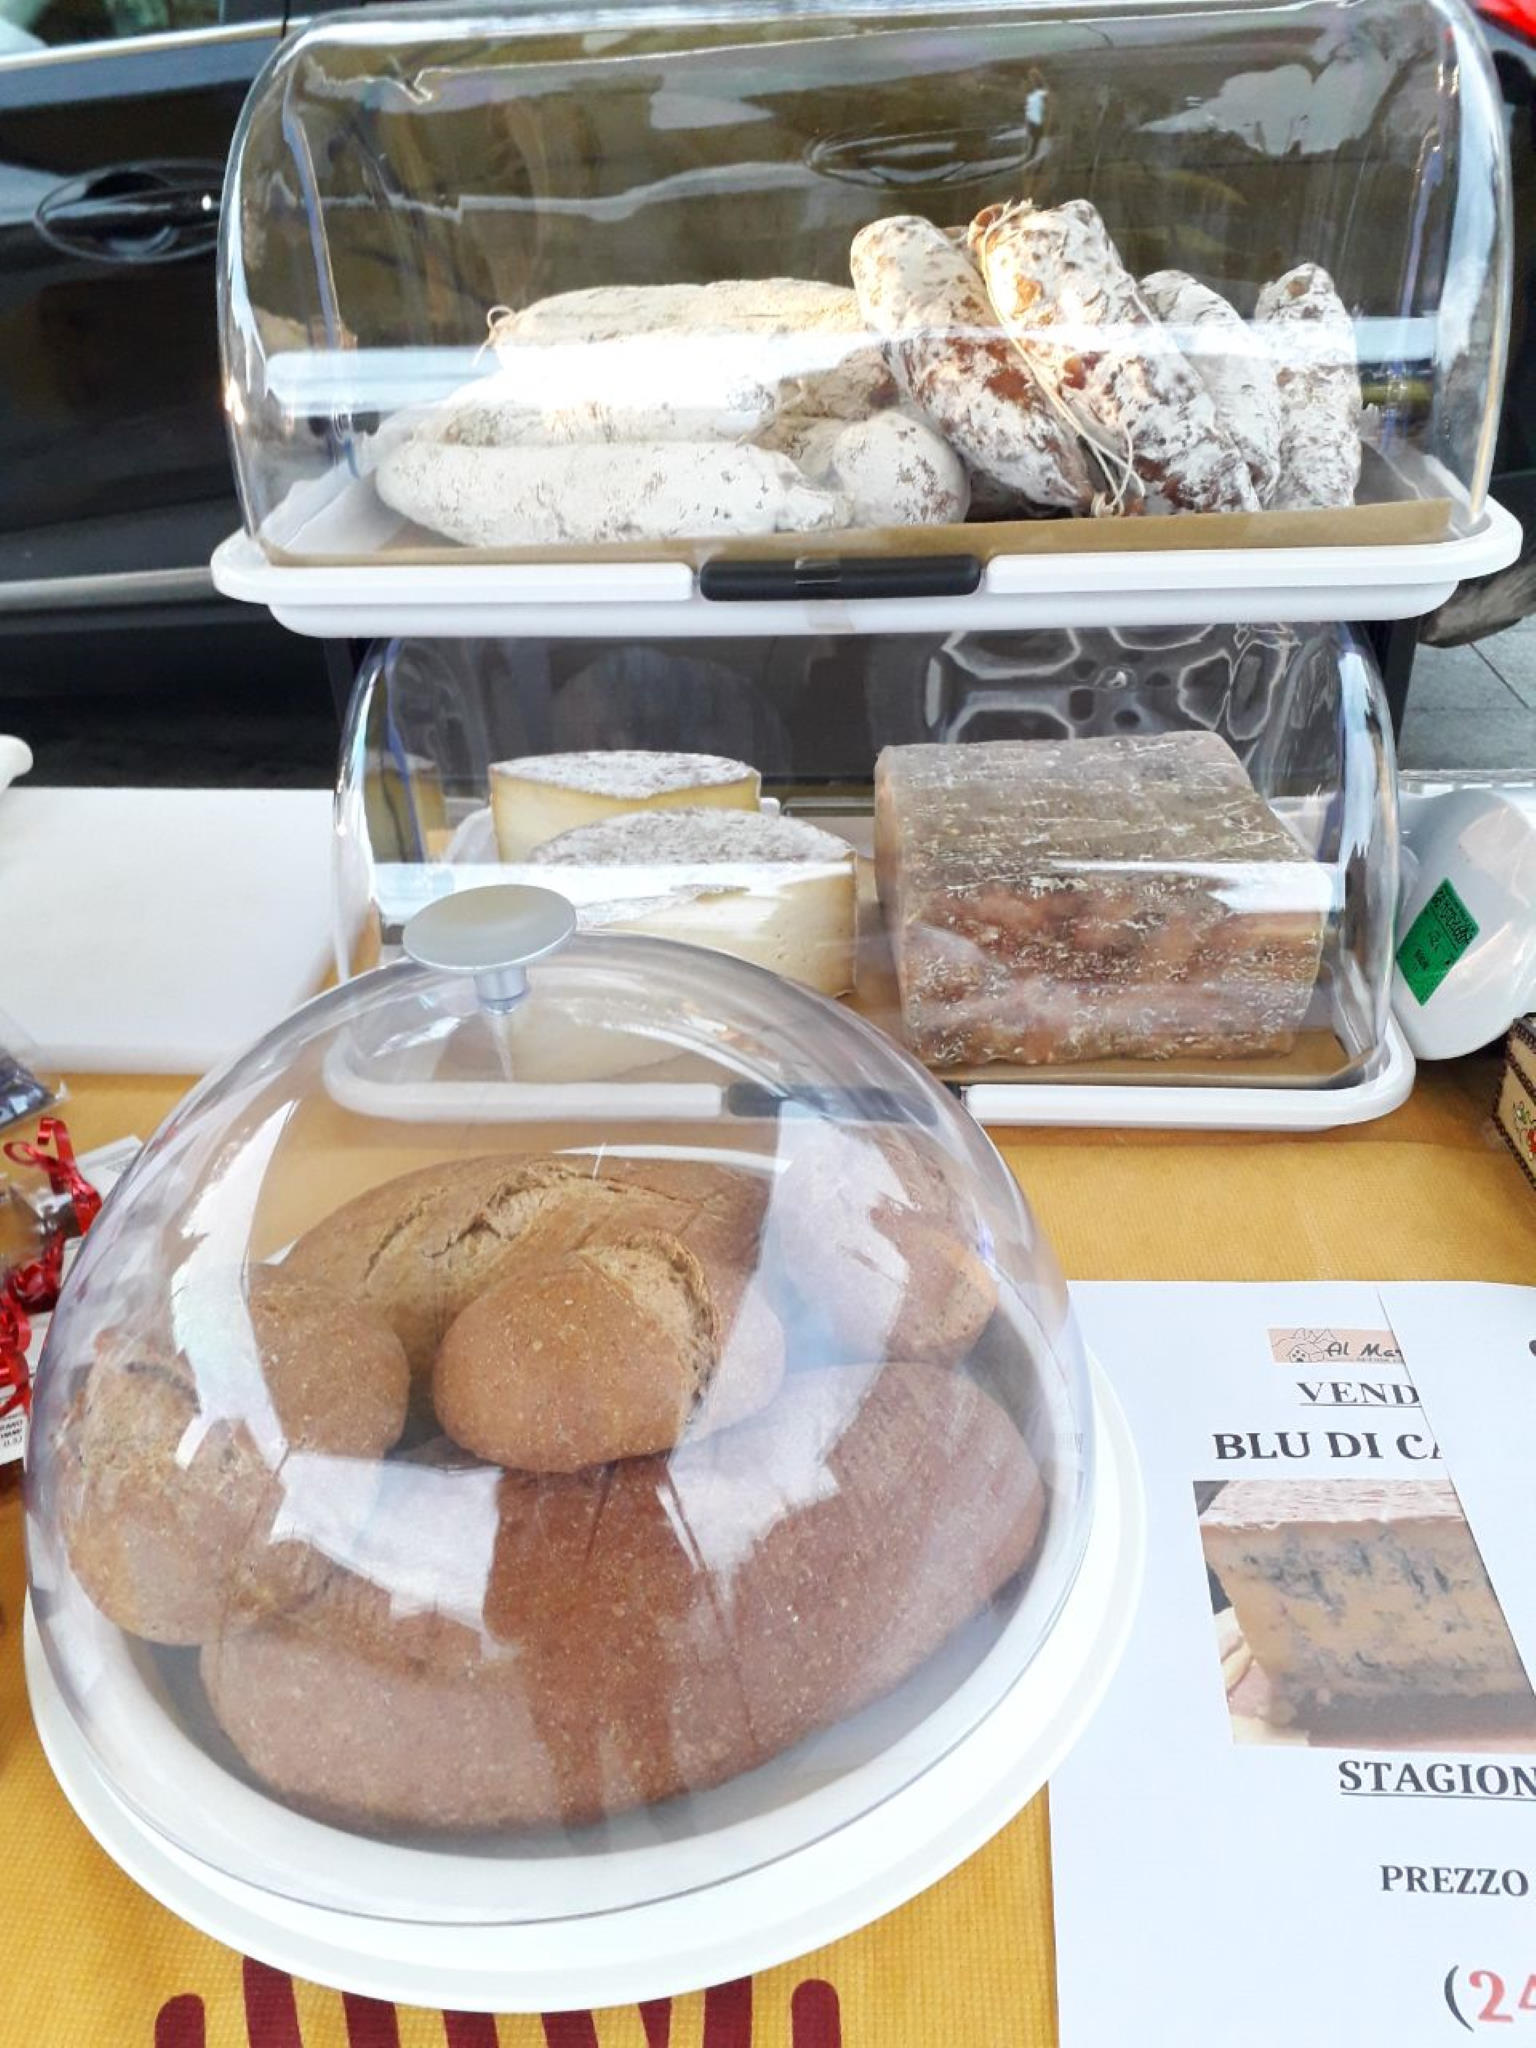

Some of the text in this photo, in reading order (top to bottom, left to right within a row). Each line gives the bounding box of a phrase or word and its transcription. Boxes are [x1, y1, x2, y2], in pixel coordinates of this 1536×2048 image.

[1324, 1341, 1350, 1357] Al
[1212, 1431, 1311, 1460] BLU
[1324, 1431, 1384, 1459] DI
[1337, 1759, 1536, 1797] STAGION
[1379, 1864, 1530, 1898] PREZZO
